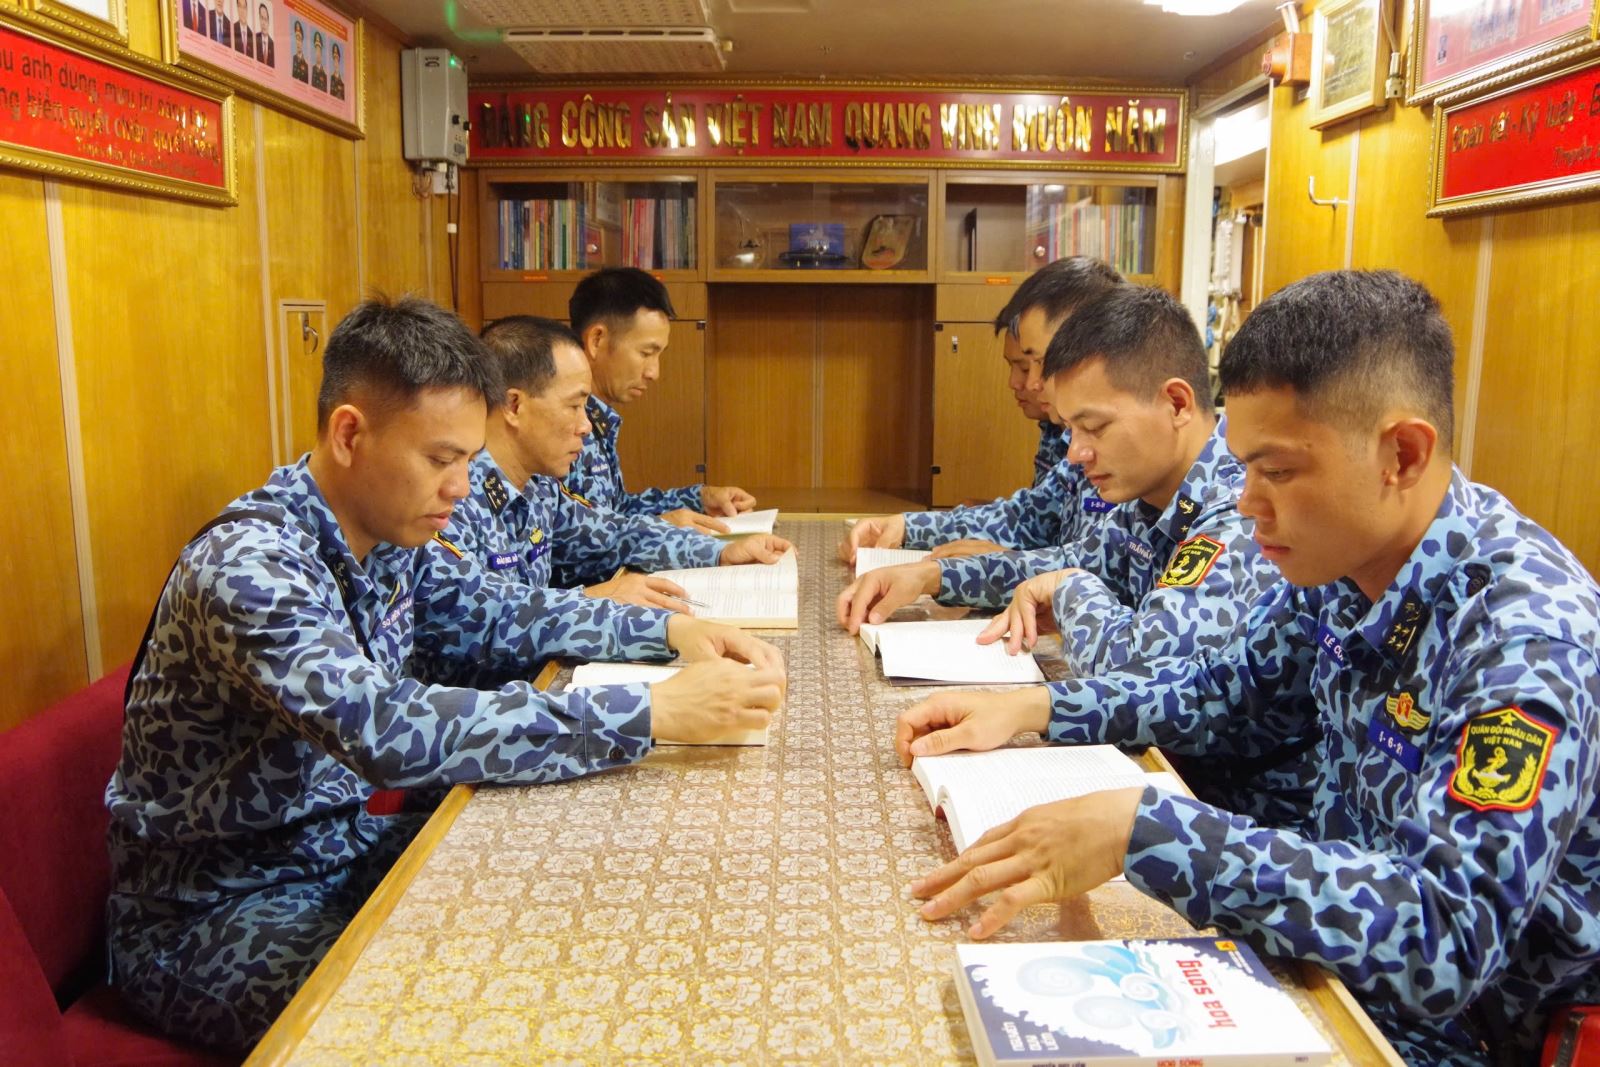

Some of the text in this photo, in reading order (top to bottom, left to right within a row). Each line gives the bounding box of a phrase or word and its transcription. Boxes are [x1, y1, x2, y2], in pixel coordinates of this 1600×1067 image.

[22, 54, 52, 82] anh
[561, 94, 632, 155] CỘNG
[704, 94, 763, 155] VIỆT
[773, 103, 832, 148] NAM
[844, 103, 932, 153] QUANG
[940, 104, 1001, 150] VINH
[1012, 96, 1092, 152] MUÔN
[1104, 99, 1167, 153] NĂM
[1471, 724, 1489, 735] QUÂN
[1504, 727, 1525, 740] NHÂN
[1526, 732, 1543, 747] DÂN
[1483, 736, 1523, 749] VIỆT NAM
[1203, 1000, 1238, 1028] hoa
